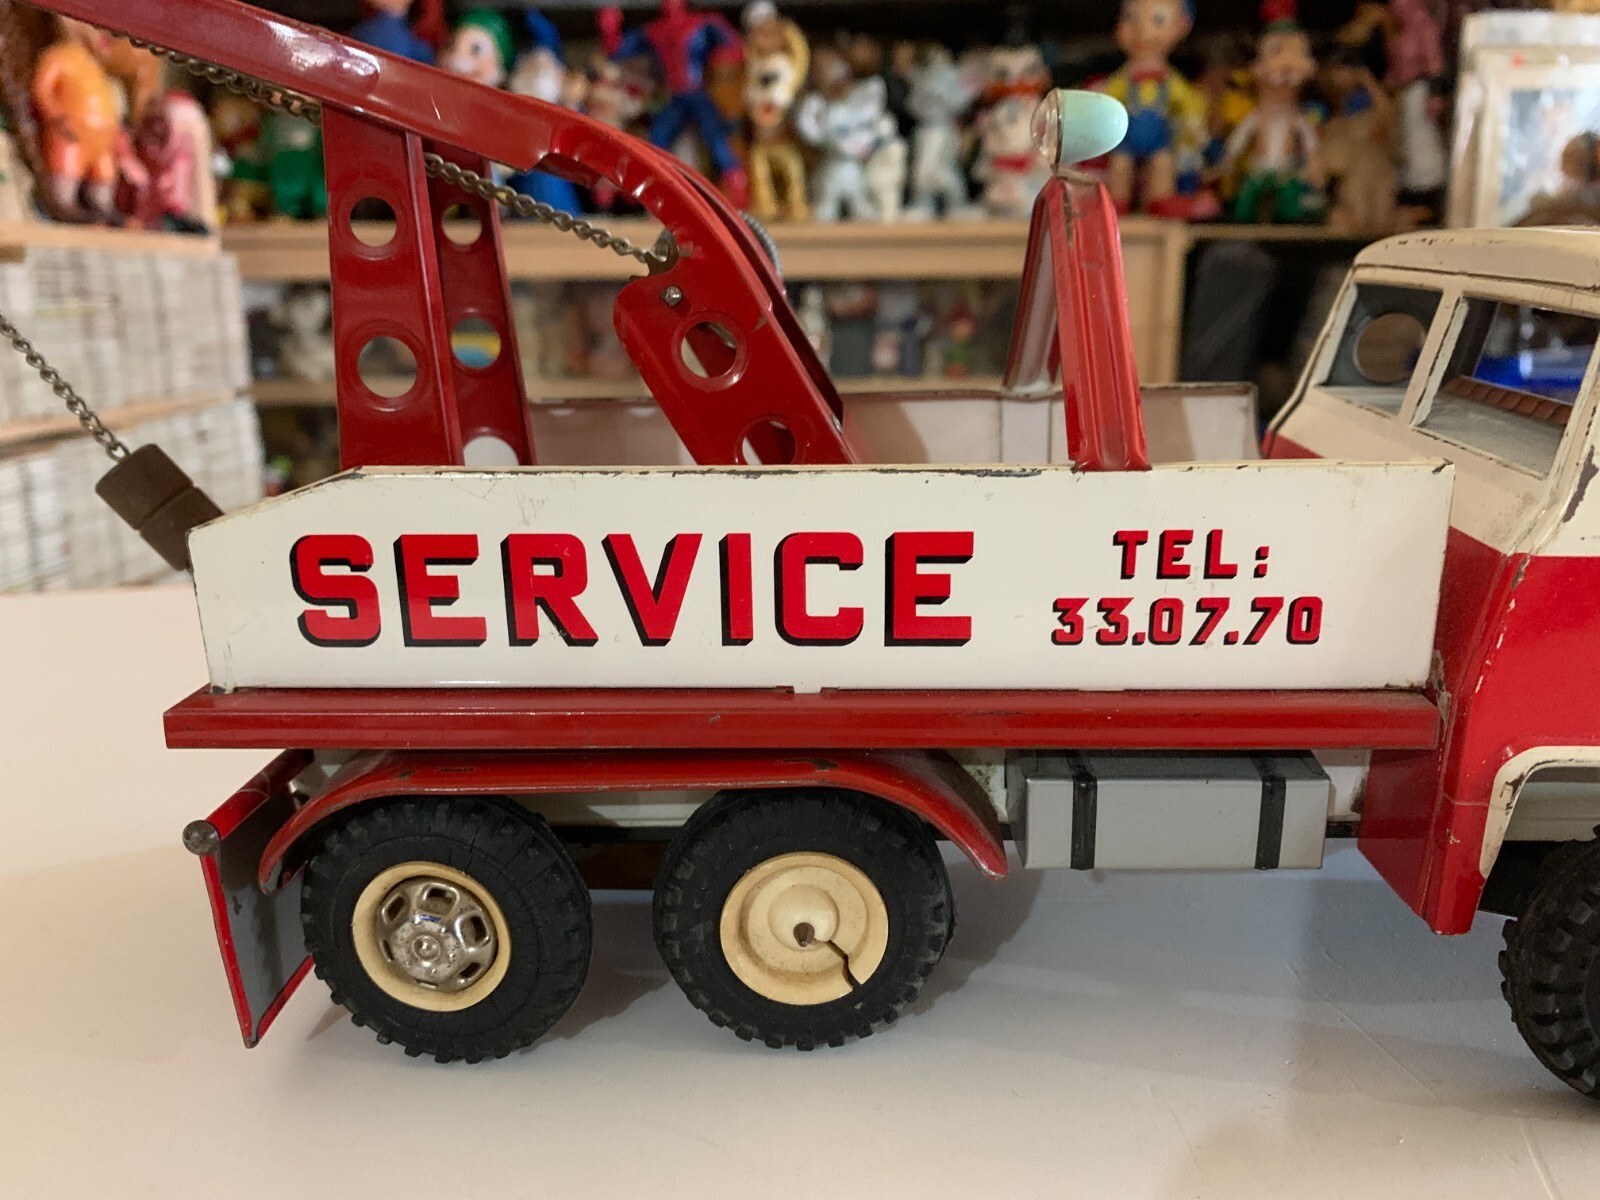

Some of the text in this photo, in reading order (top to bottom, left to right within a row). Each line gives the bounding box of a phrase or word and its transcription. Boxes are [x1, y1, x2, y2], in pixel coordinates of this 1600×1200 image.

[1113, 529, 1269, 579] TEL:
[289, 532, 974, 647] SERVICE
[1051, 597, 1322, 645] 33.07.70
